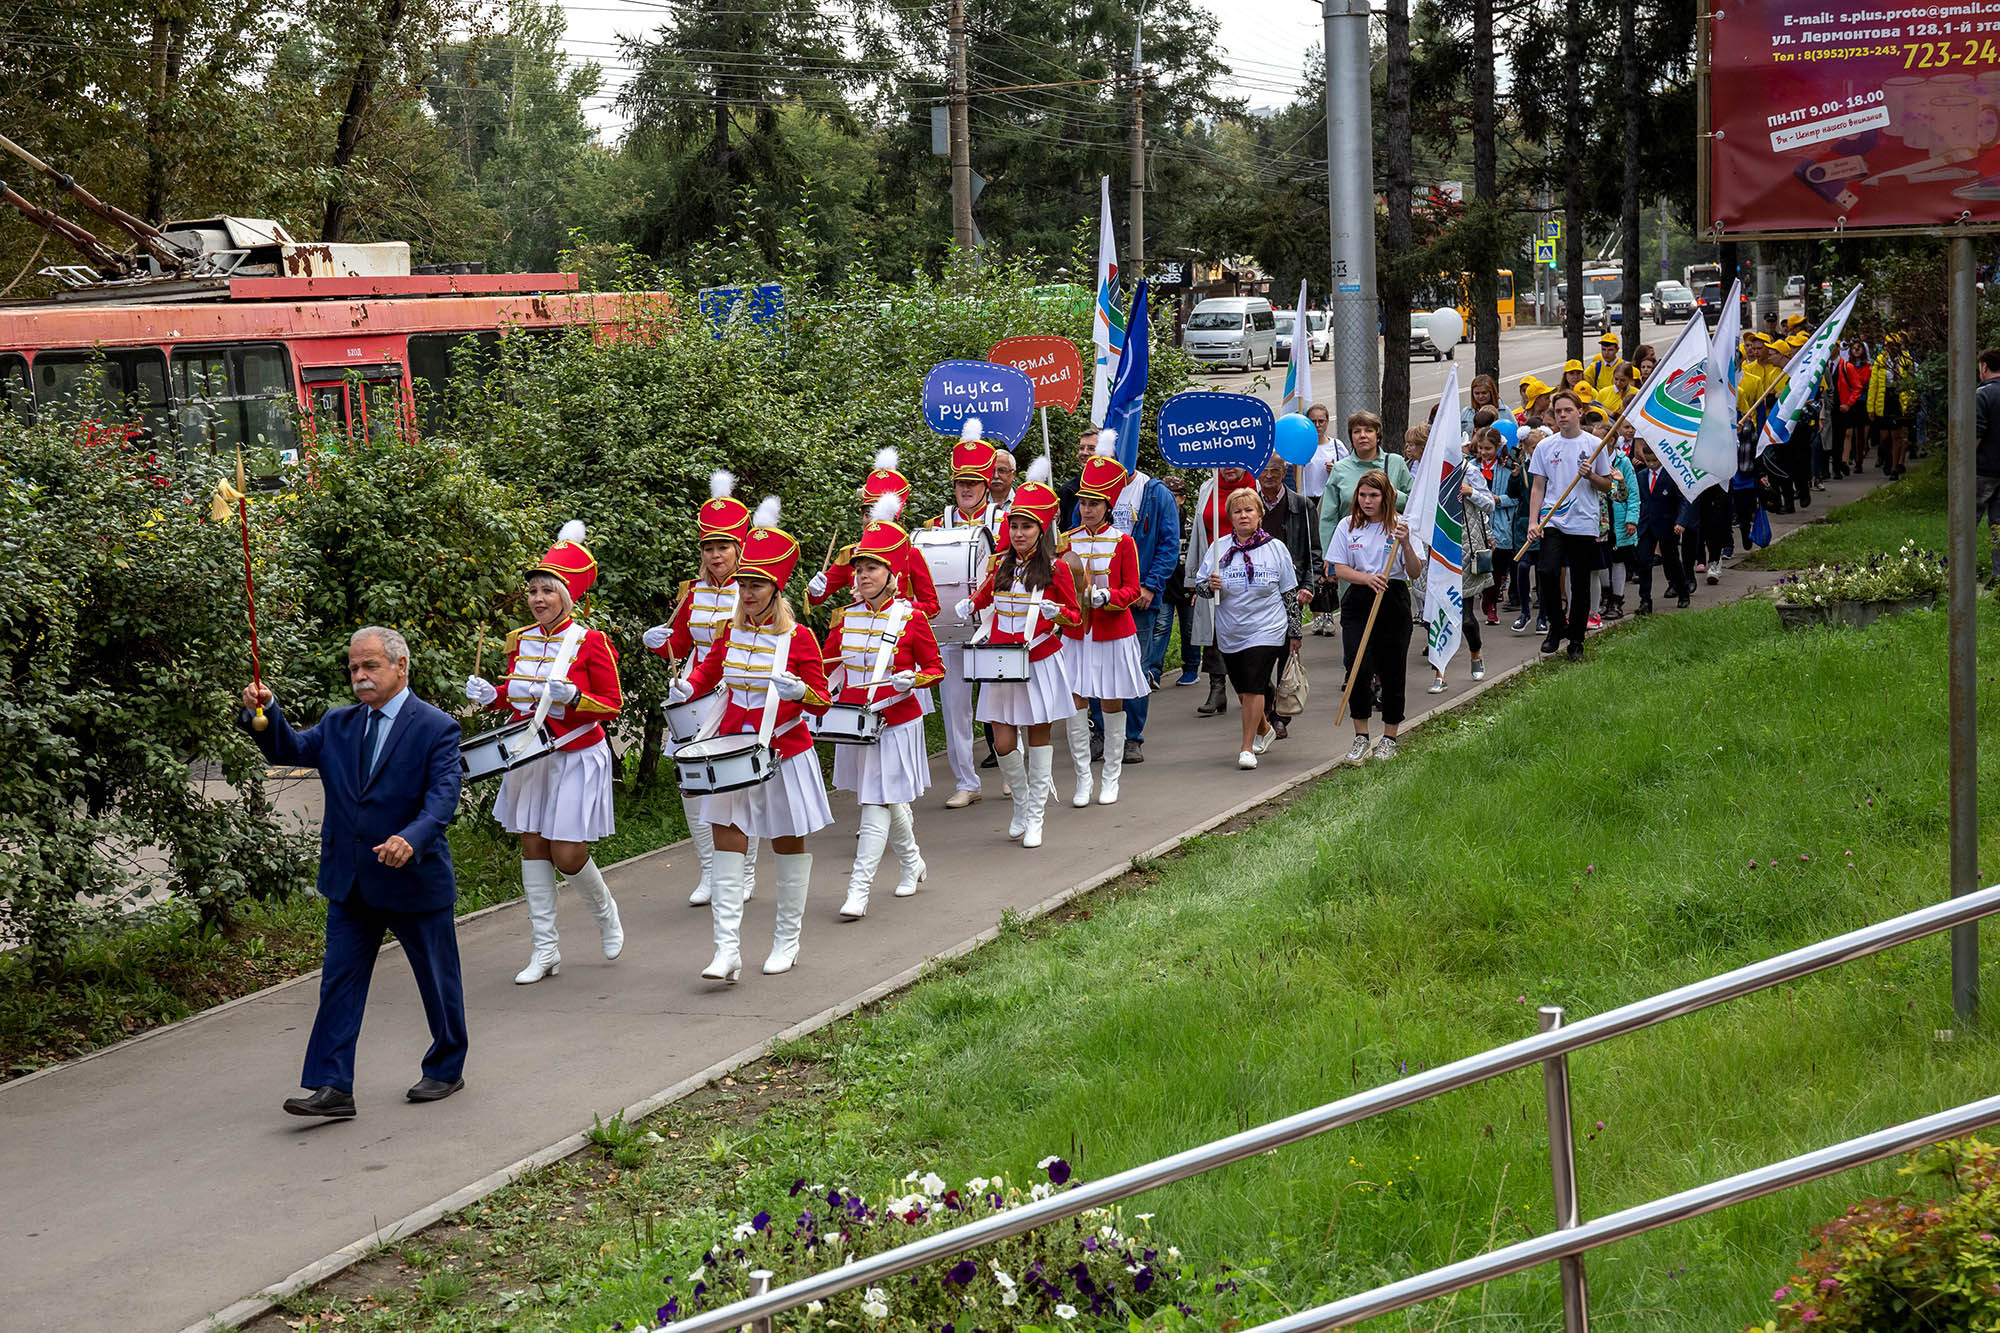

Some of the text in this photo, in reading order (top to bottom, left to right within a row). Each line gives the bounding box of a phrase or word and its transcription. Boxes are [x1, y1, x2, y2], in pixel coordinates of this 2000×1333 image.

[1784, 11, 1834, 26] E-mail:
[1772, 34, 1796, 46] ул.
[1801, 27, 1900, 43] Лермонтова
[1903, 39, 2000, 69] 723-24
[1767, 108, 1806, 127] ПН-ПТ
[1846, 90, 1884, 109] 18.00
[1795, 128, 1820, 140] Центр
[1822, 121, 1847, 133] нашего
[943, 381, 1003, 399] Наука
[939, 397, 1009, 420] рулит!
[1168, 417, 1262, 436] Побеждаем
[1179, 435, 1256, 453] темноту
[1658, 439, 1696, 489] ИРКУТСК
